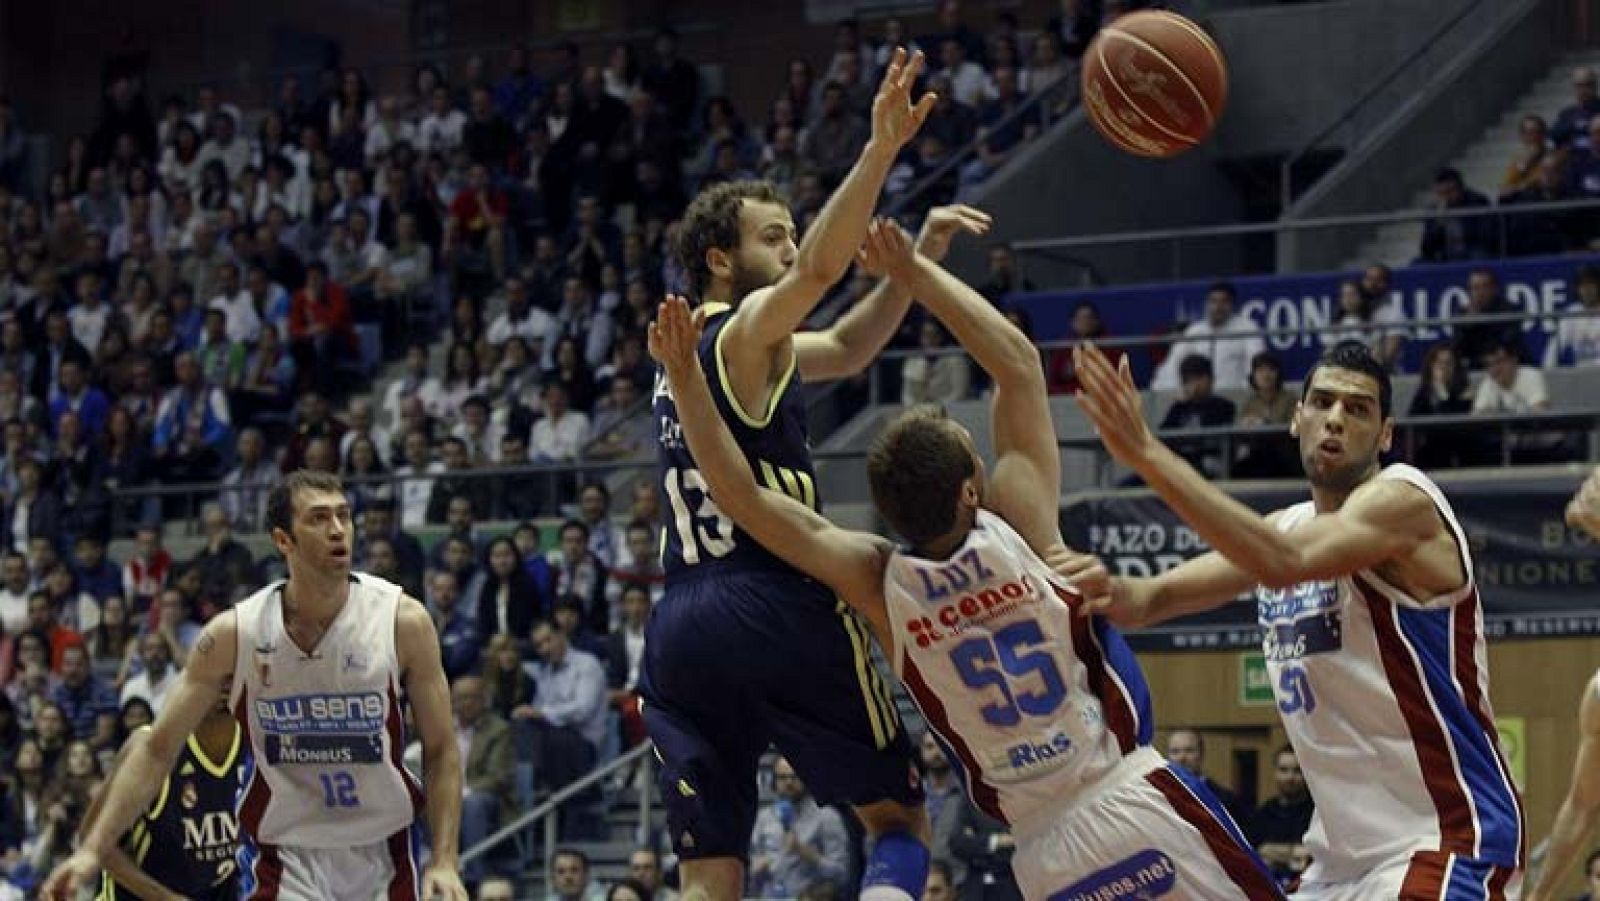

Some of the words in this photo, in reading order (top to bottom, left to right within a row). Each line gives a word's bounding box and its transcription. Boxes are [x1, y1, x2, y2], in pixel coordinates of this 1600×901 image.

[914, 549, 995, 600] LUZ
[950, 618, 1067, 727] 55
[319, 770, 360, 808] 12
